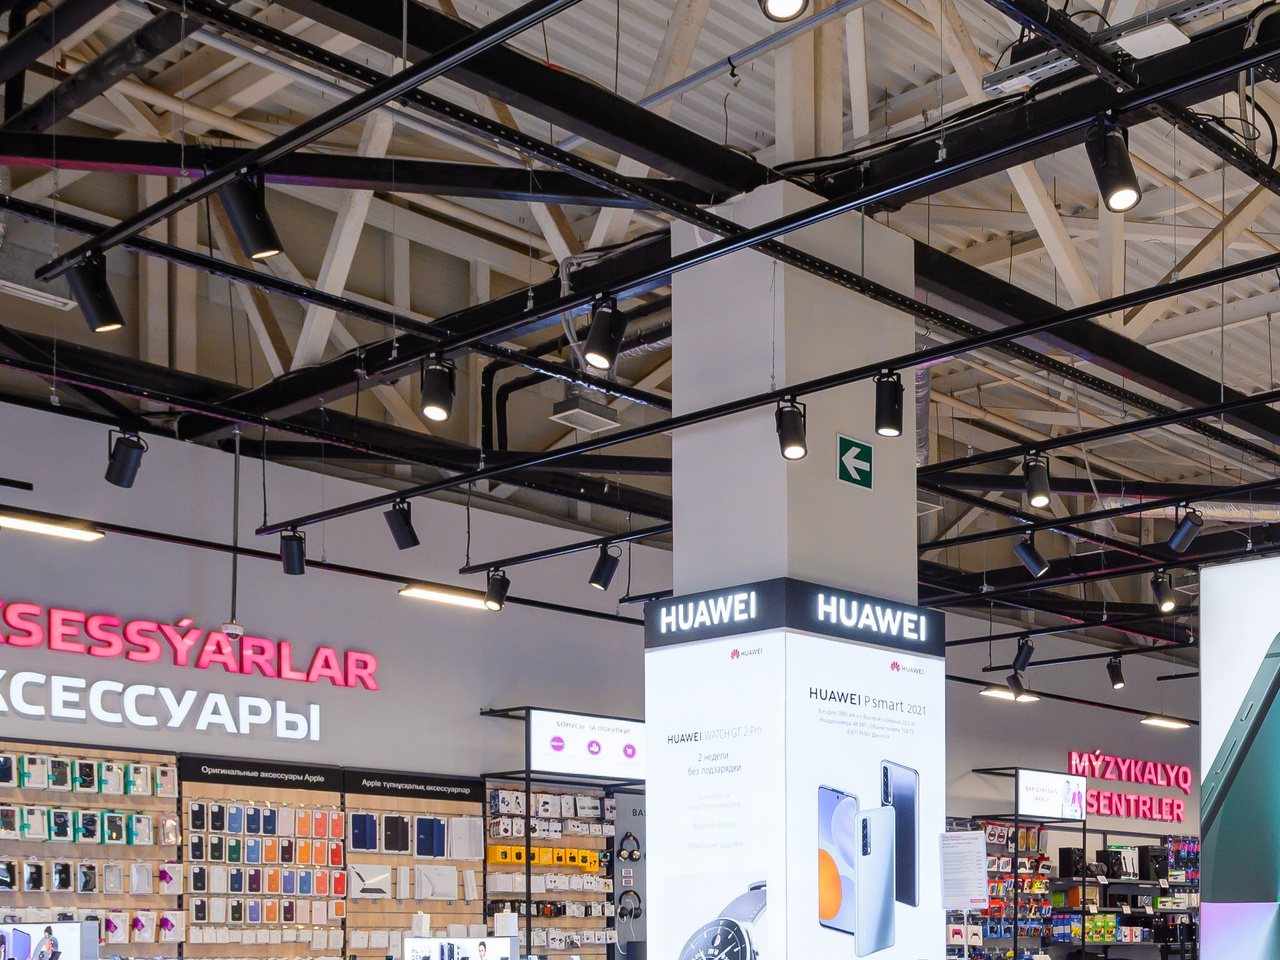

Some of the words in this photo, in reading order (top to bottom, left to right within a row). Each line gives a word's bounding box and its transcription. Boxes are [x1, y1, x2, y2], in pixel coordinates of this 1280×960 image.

[660, 591, 757, 634] HUAWEI
[817, 593, 927, 642] HUAWEI
[740, 648, 763, 657] HUAWEI
[901, 665, 924, 675] HUAWEI
[809, 687, 861, 706] HUAWEI
[872, 698, 904, 713] smart
[907, 703, 926, 716] 2021
[588, 724, 597, 732] ЗА
[667, 731, 702, 744] HUAWEI
[704, 728, 730, 741] WATCH
[731, 726, 741, 738] GT
[743, 726, 748, 737] 2
[749, 725, 762, 736] Pro
[697, 753, 702, 762] 2
[703, 752, 729, 762] недели
[201, 765, 259, 778] Оригинальные
[260, 771, 303, 782] аксессуары
[304, 773, 325, 783] Apple
[687, 767, 699, 776] без
[700, 764, 742, 776] подзарядки
[1068, 749, 1192, 796] MÝZYKALYQ
[361, 778, 382, 788] Apple
[1086, 788, 1186, 824] SENTRLER
